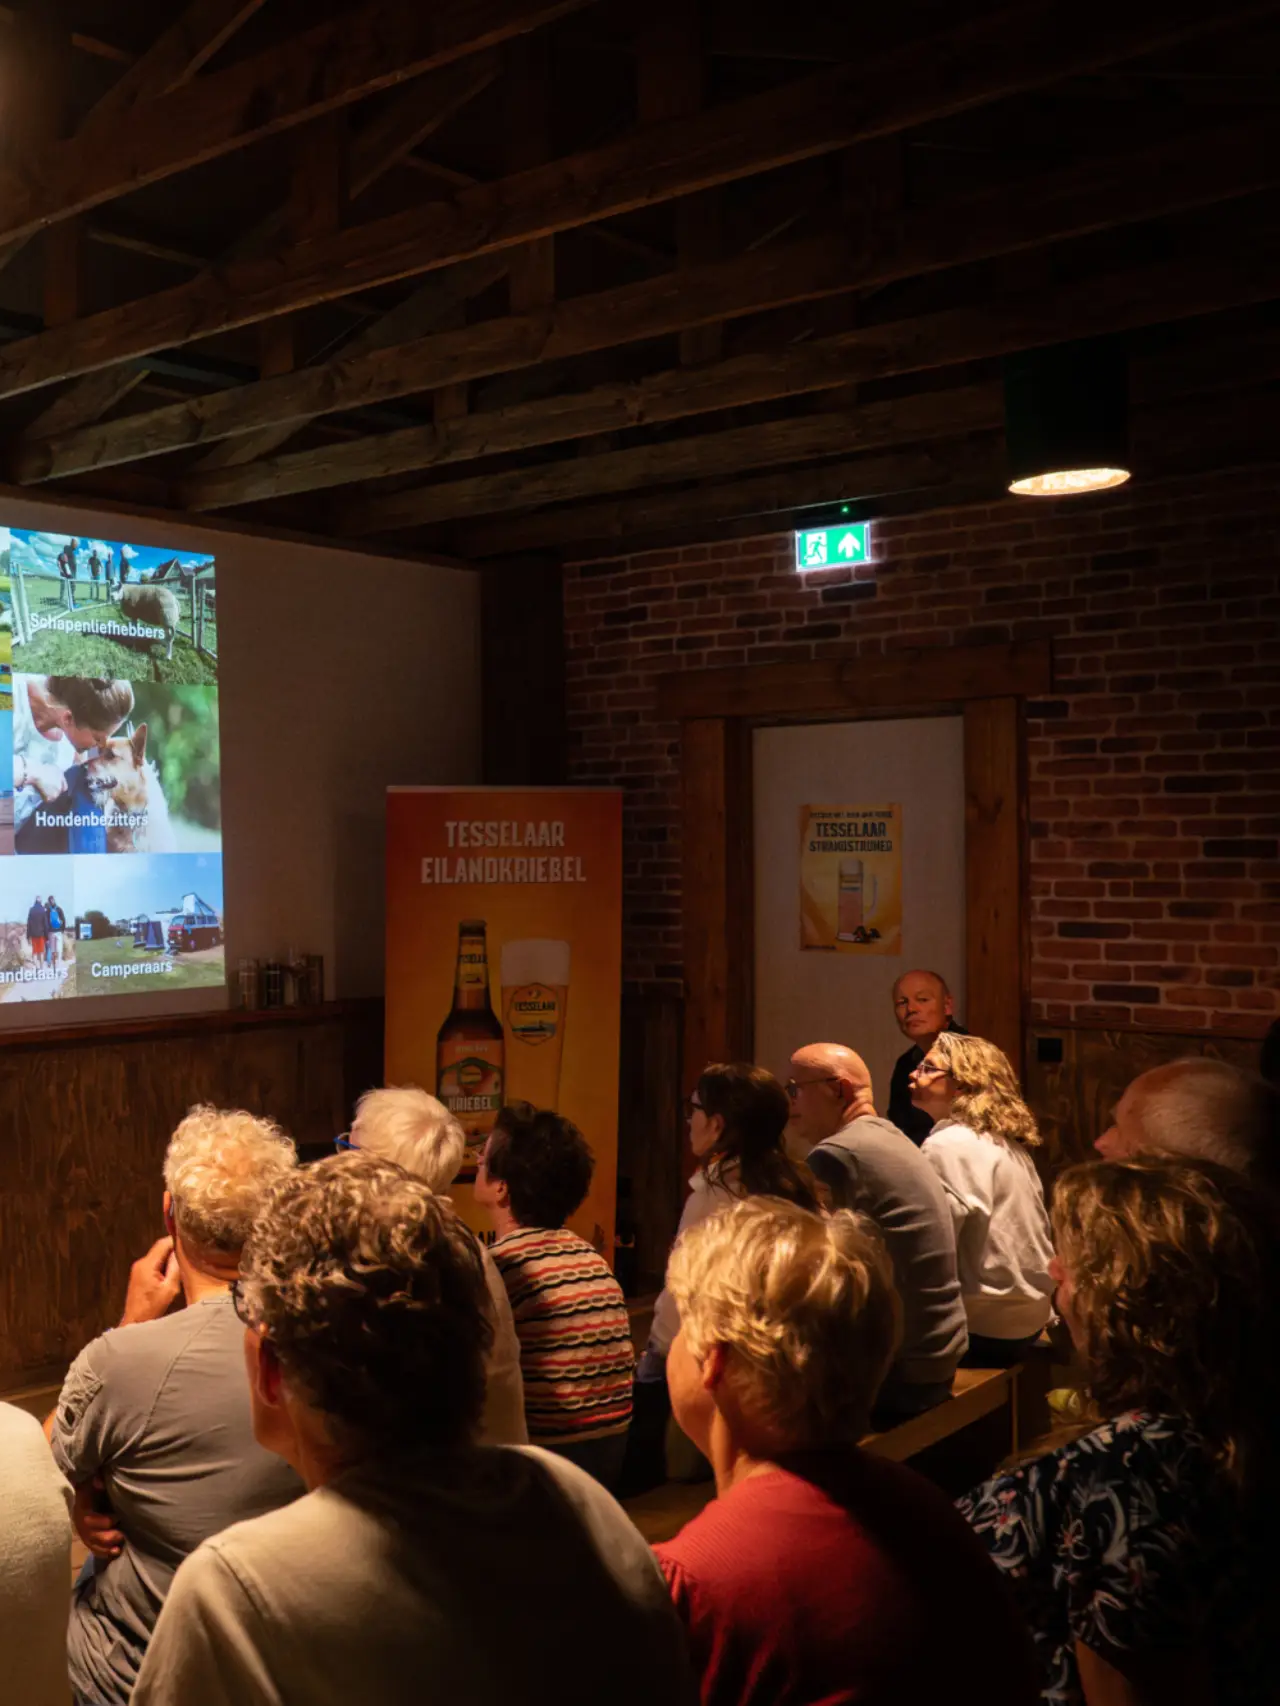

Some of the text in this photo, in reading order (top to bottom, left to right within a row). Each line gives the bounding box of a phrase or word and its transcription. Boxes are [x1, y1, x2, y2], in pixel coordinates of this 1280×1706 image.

[30, 613, 165, 640] Schapenliefhebbers
[35, 811, 148, 829] Hondenbezitters
[816, 821, 887, 837] TESSELAAR
[445, 820, 565, 848] TESSELAAR
[421, 856, 587, 884] EILANDKRIEBEL
[91, 960, 173, 979] Camperaars
